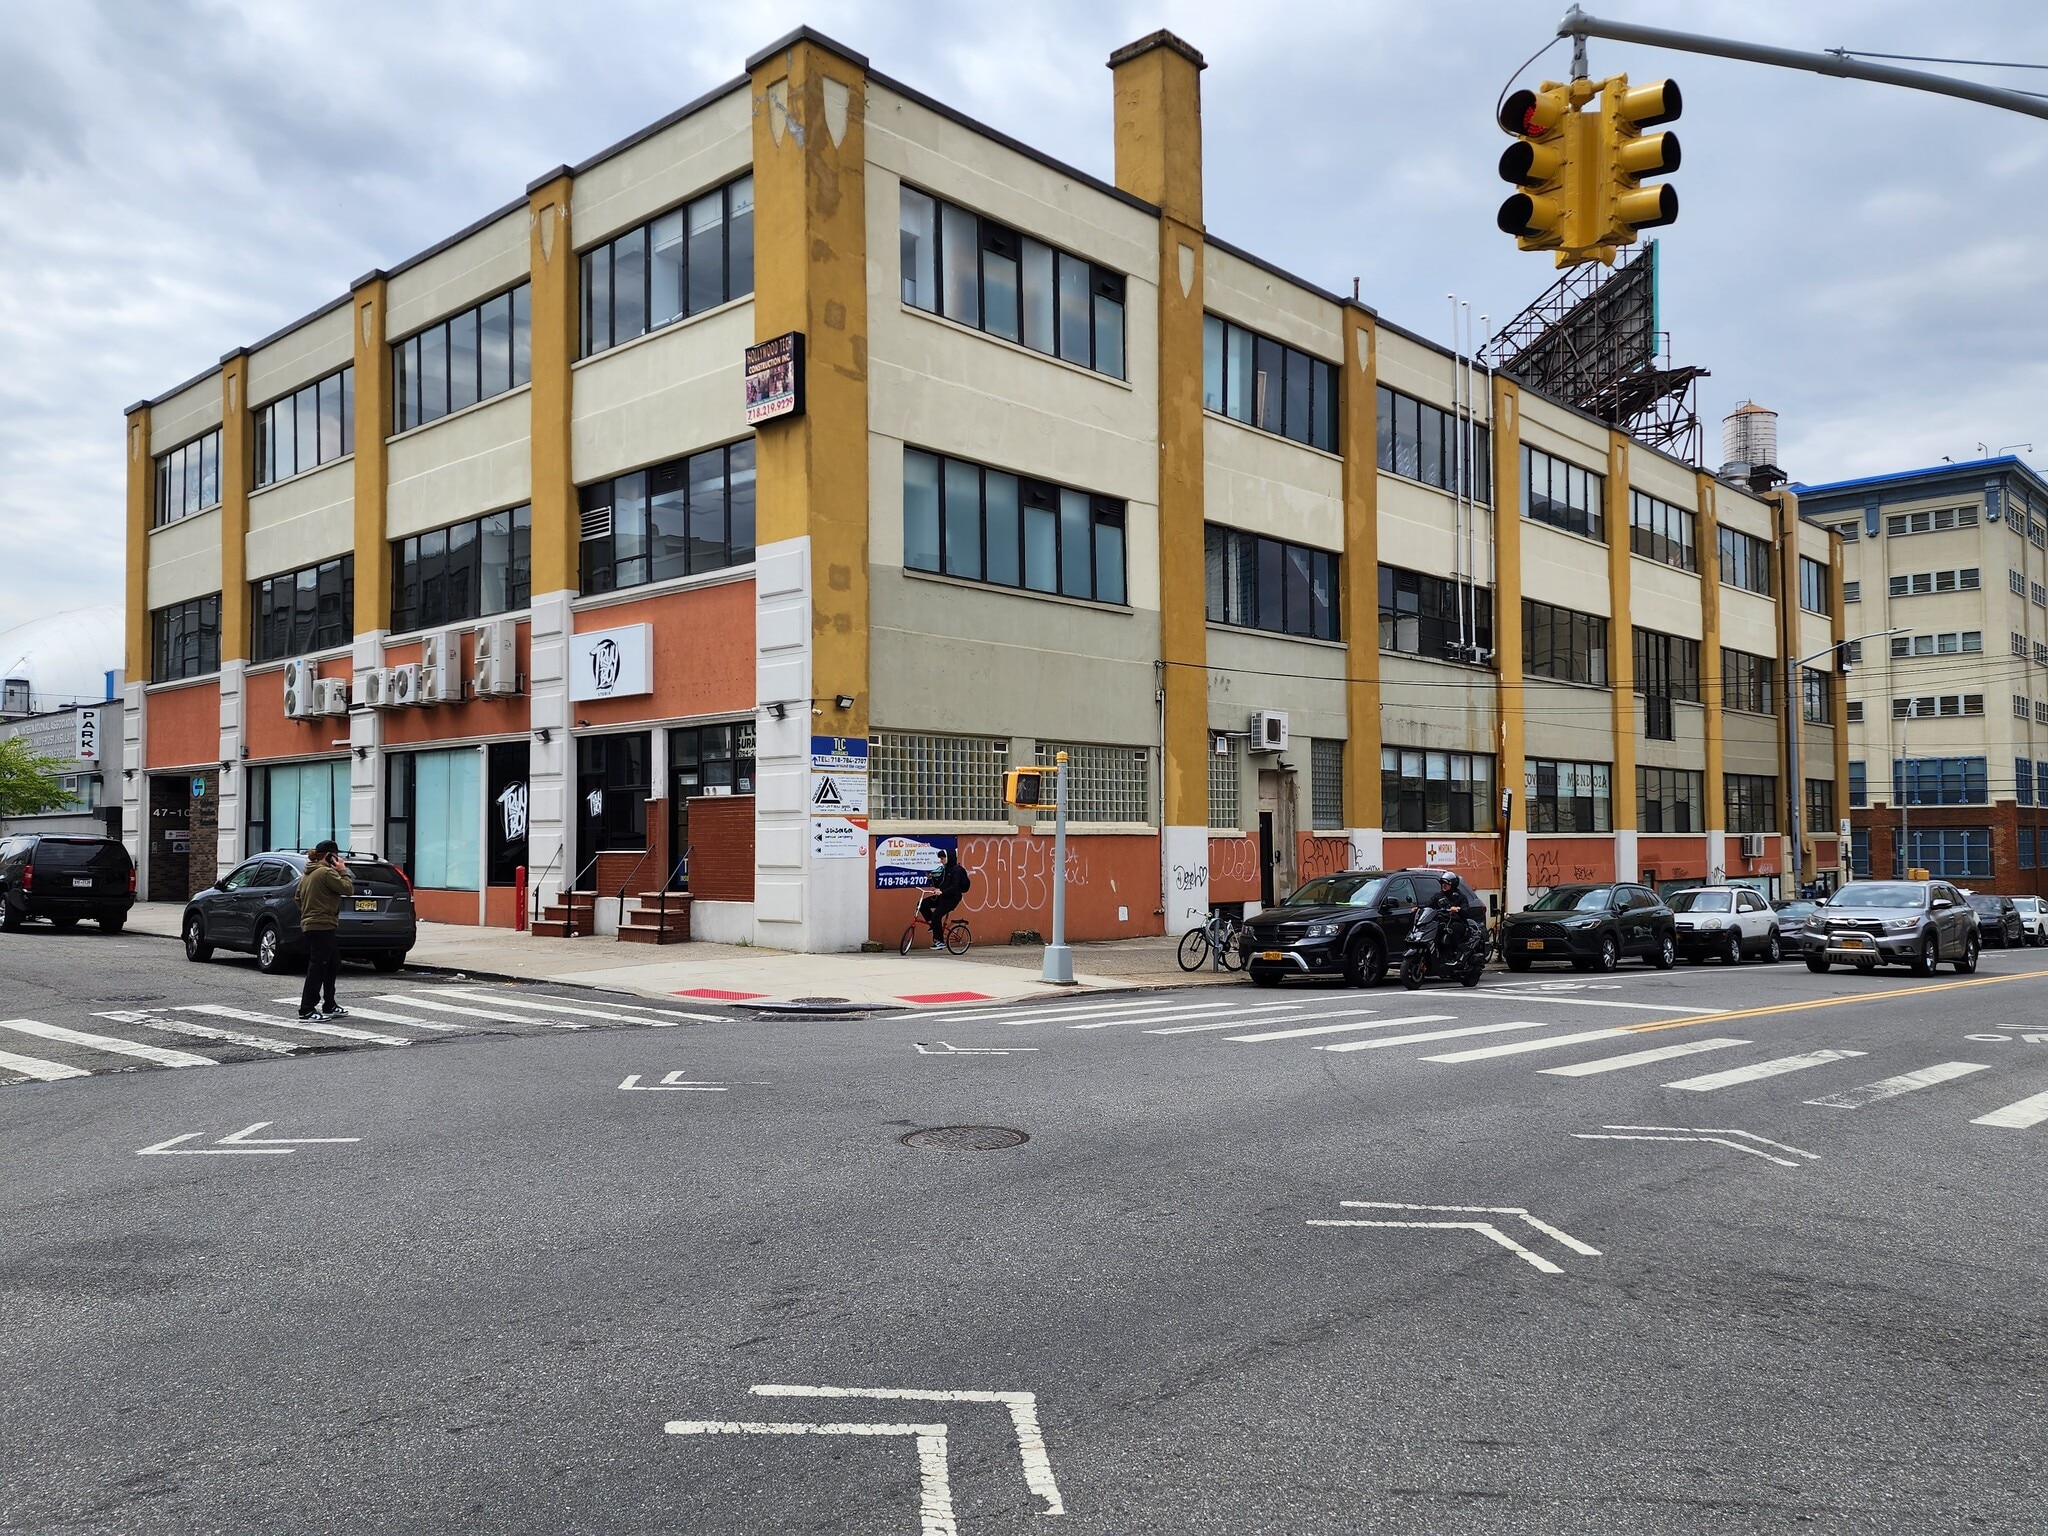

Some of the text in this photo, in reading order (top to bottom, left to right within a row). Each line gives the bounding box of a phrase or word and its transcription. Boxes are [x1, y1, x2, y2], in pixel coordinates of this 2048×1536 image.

[748, 357, 781, 374] CONSTRUCTION
[81, 711, 95, 748] PARK
[833, 738, 847, 751] TLC
[888, 840, 904, 848] TLC
[879, 877, 928, 886] 718-784-2707
